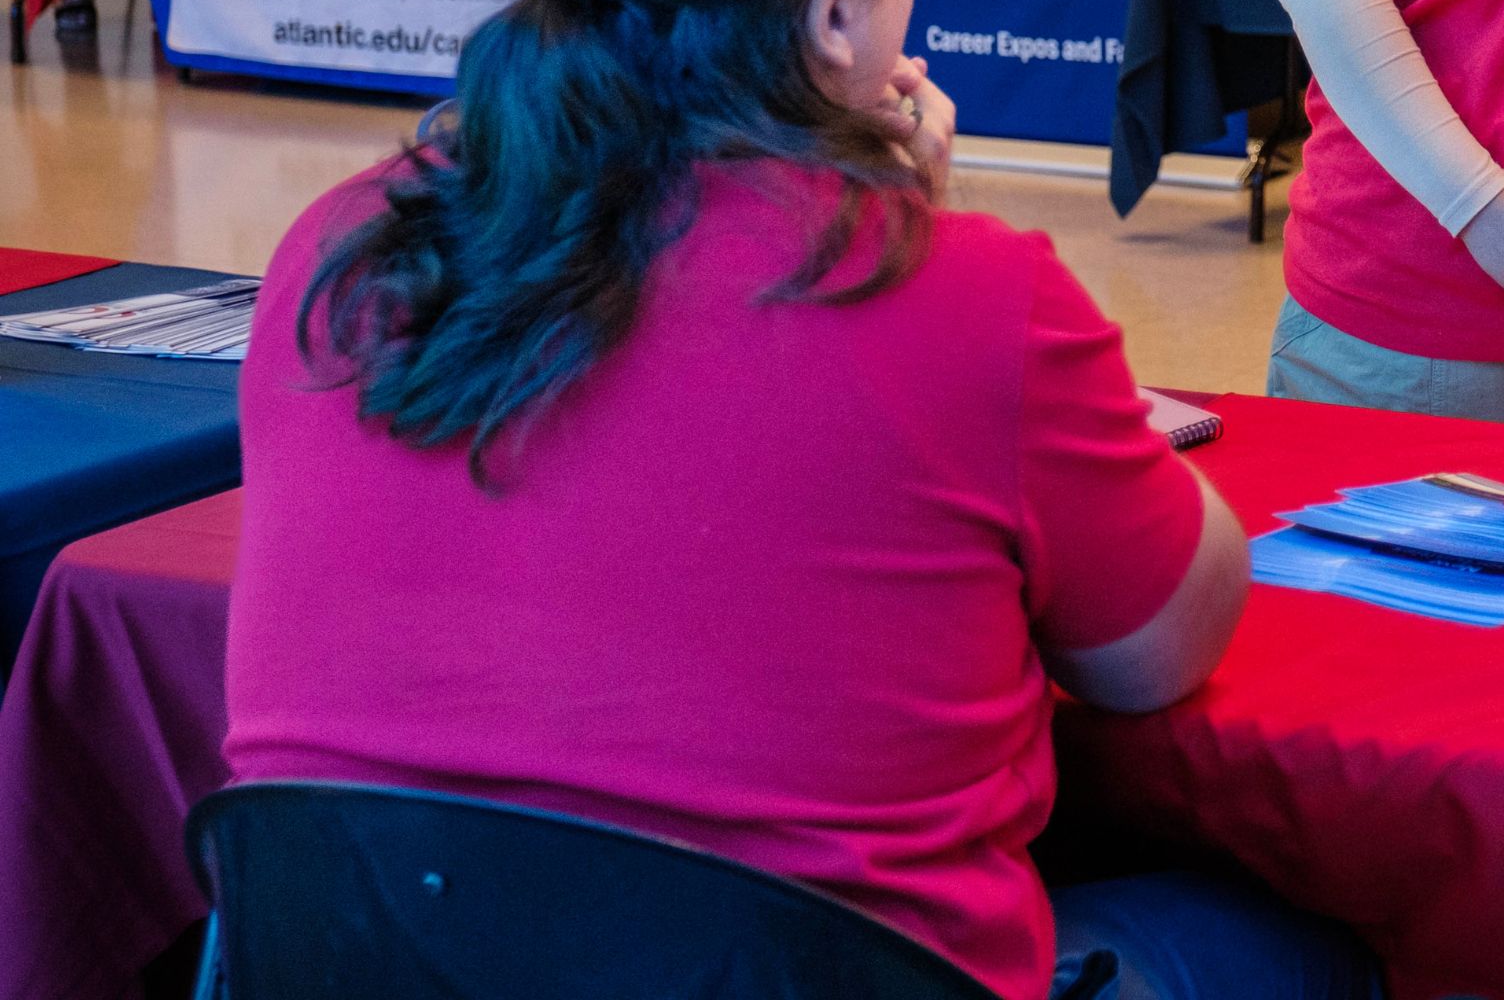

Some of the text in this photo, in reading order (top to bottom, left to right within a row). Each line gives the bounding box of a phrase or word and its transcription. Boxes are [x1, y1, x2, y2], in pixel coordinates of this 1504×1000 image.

[926, 25, 994, 54] Career
[996, 30, 1060, 65] Expos
[1061, 34, 1102, 63] and
